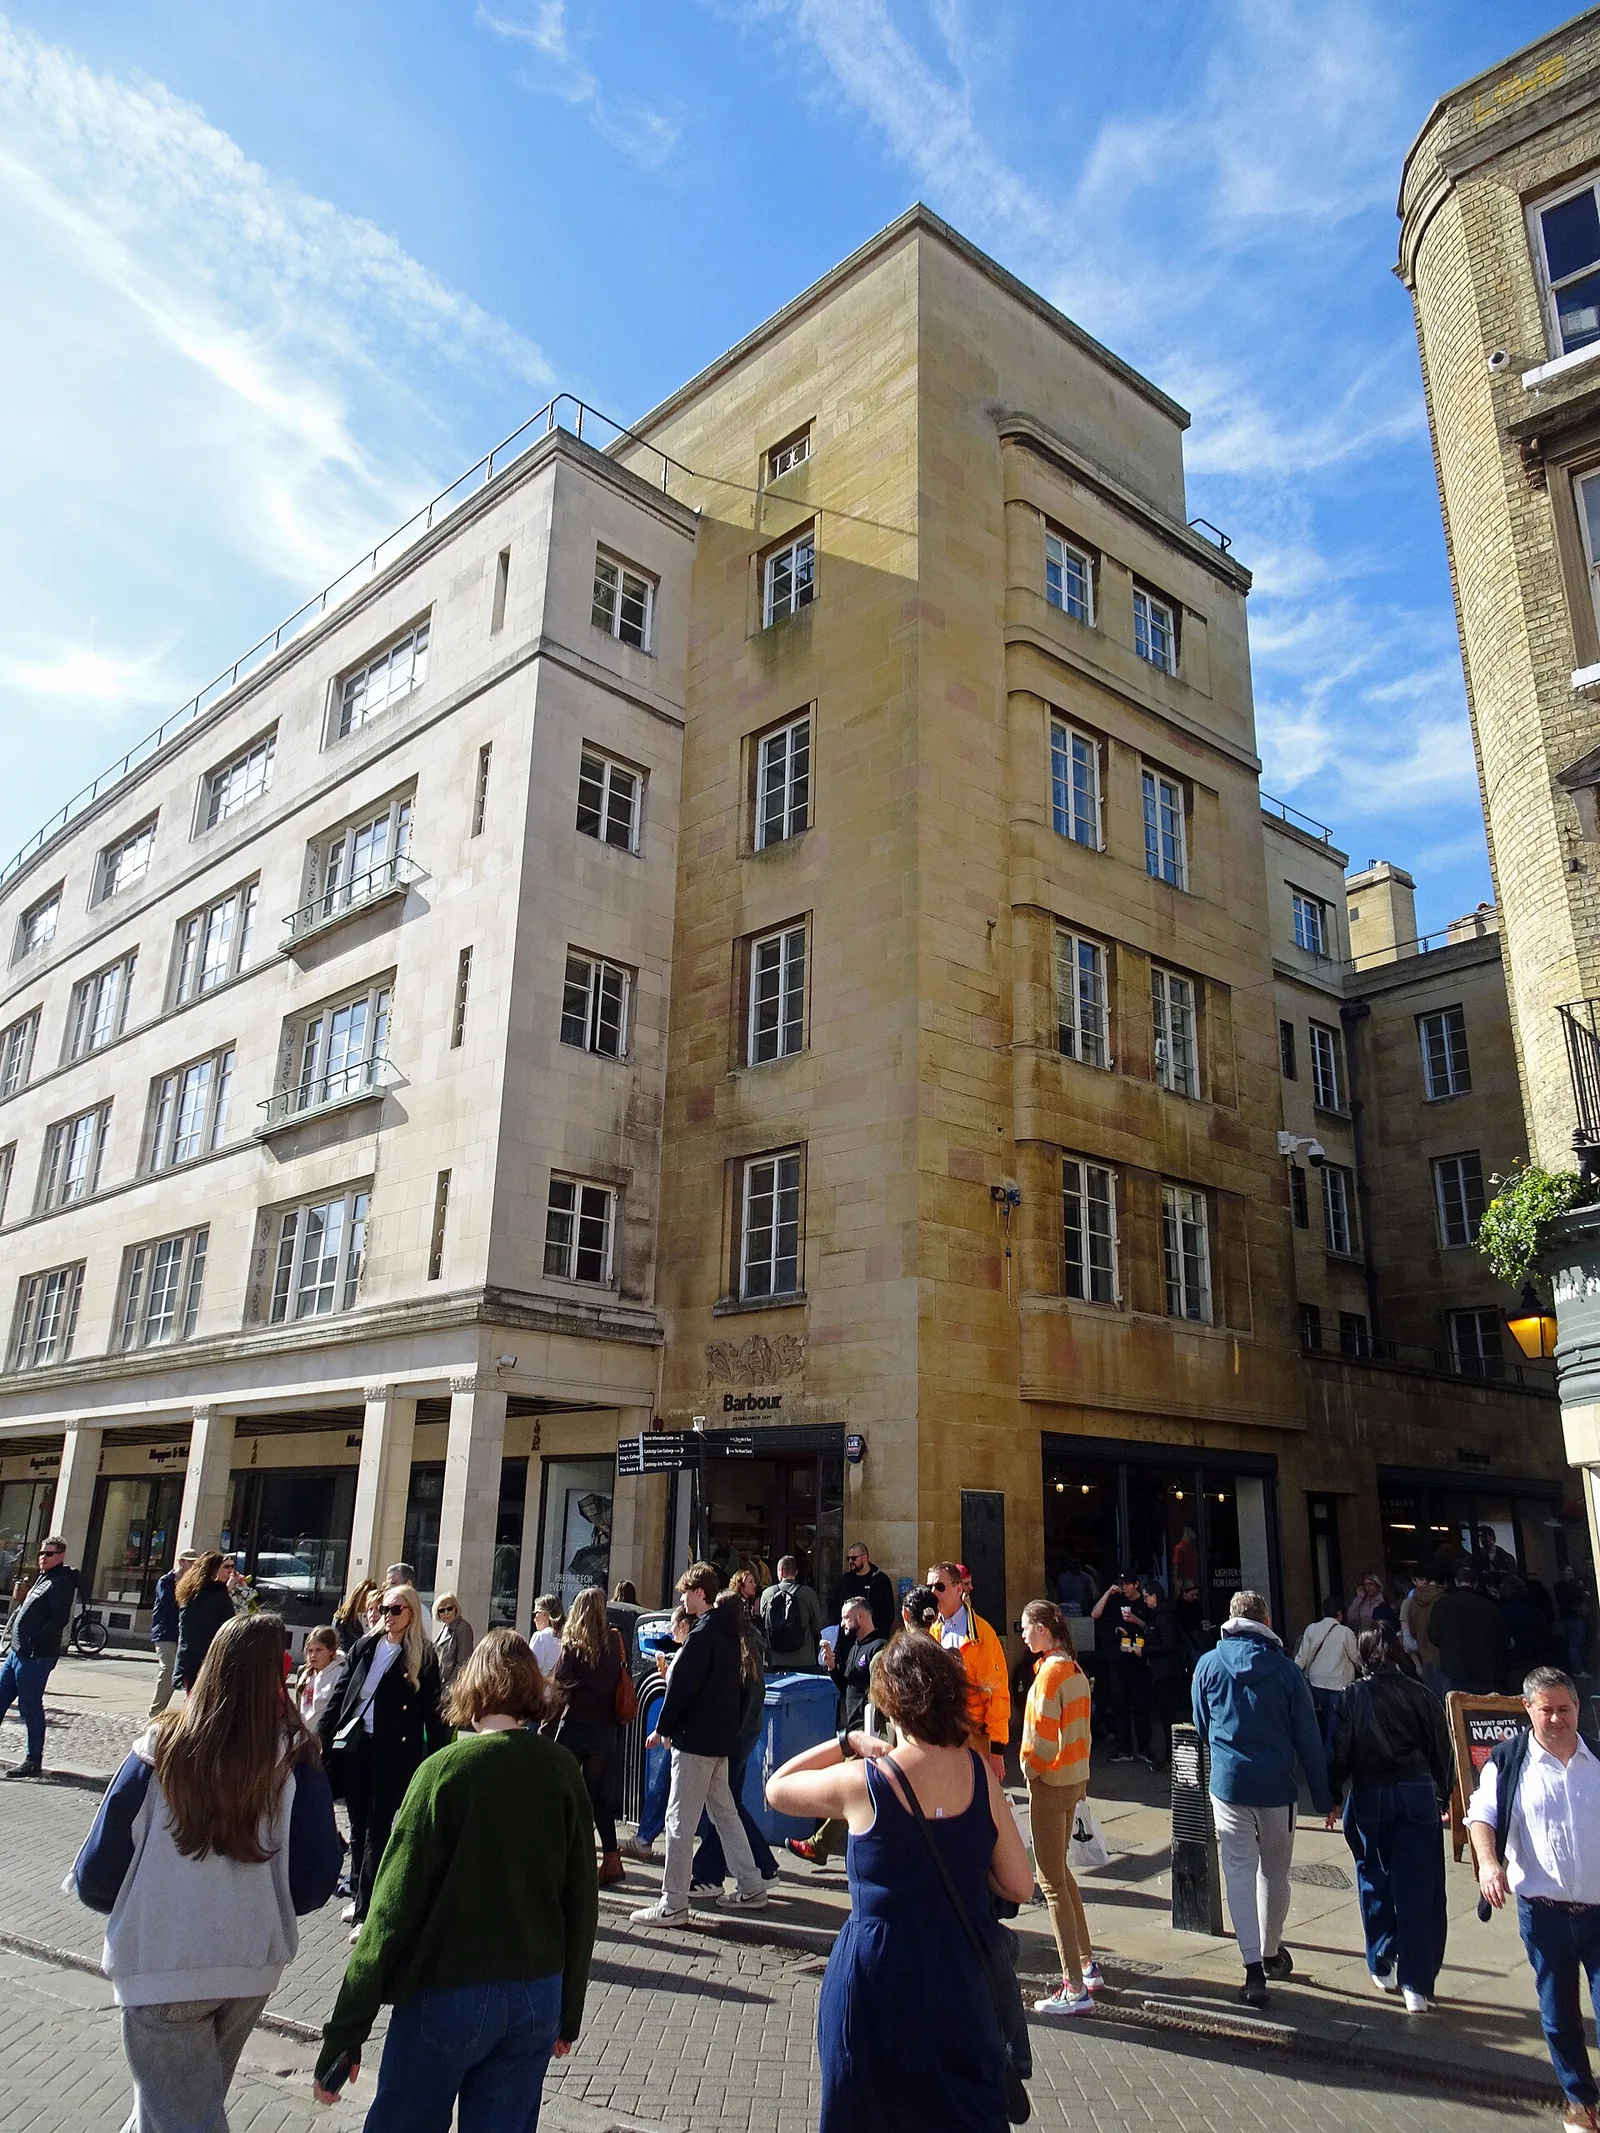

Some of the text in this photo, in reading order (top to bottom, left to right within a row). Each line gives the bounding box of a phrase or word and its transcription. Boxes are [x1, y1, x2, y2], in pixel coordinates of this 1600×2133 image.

[723, 1392, 782, 1412] Barbour
[1214, 1568, 1239, 1578] LIGHTER
[554, 1573, 594, 1584] PREPARE FOR
[1213, 1579, 1242, 1588] FOR LIGHT
[549, 1582, 567, 1592] EVERY
